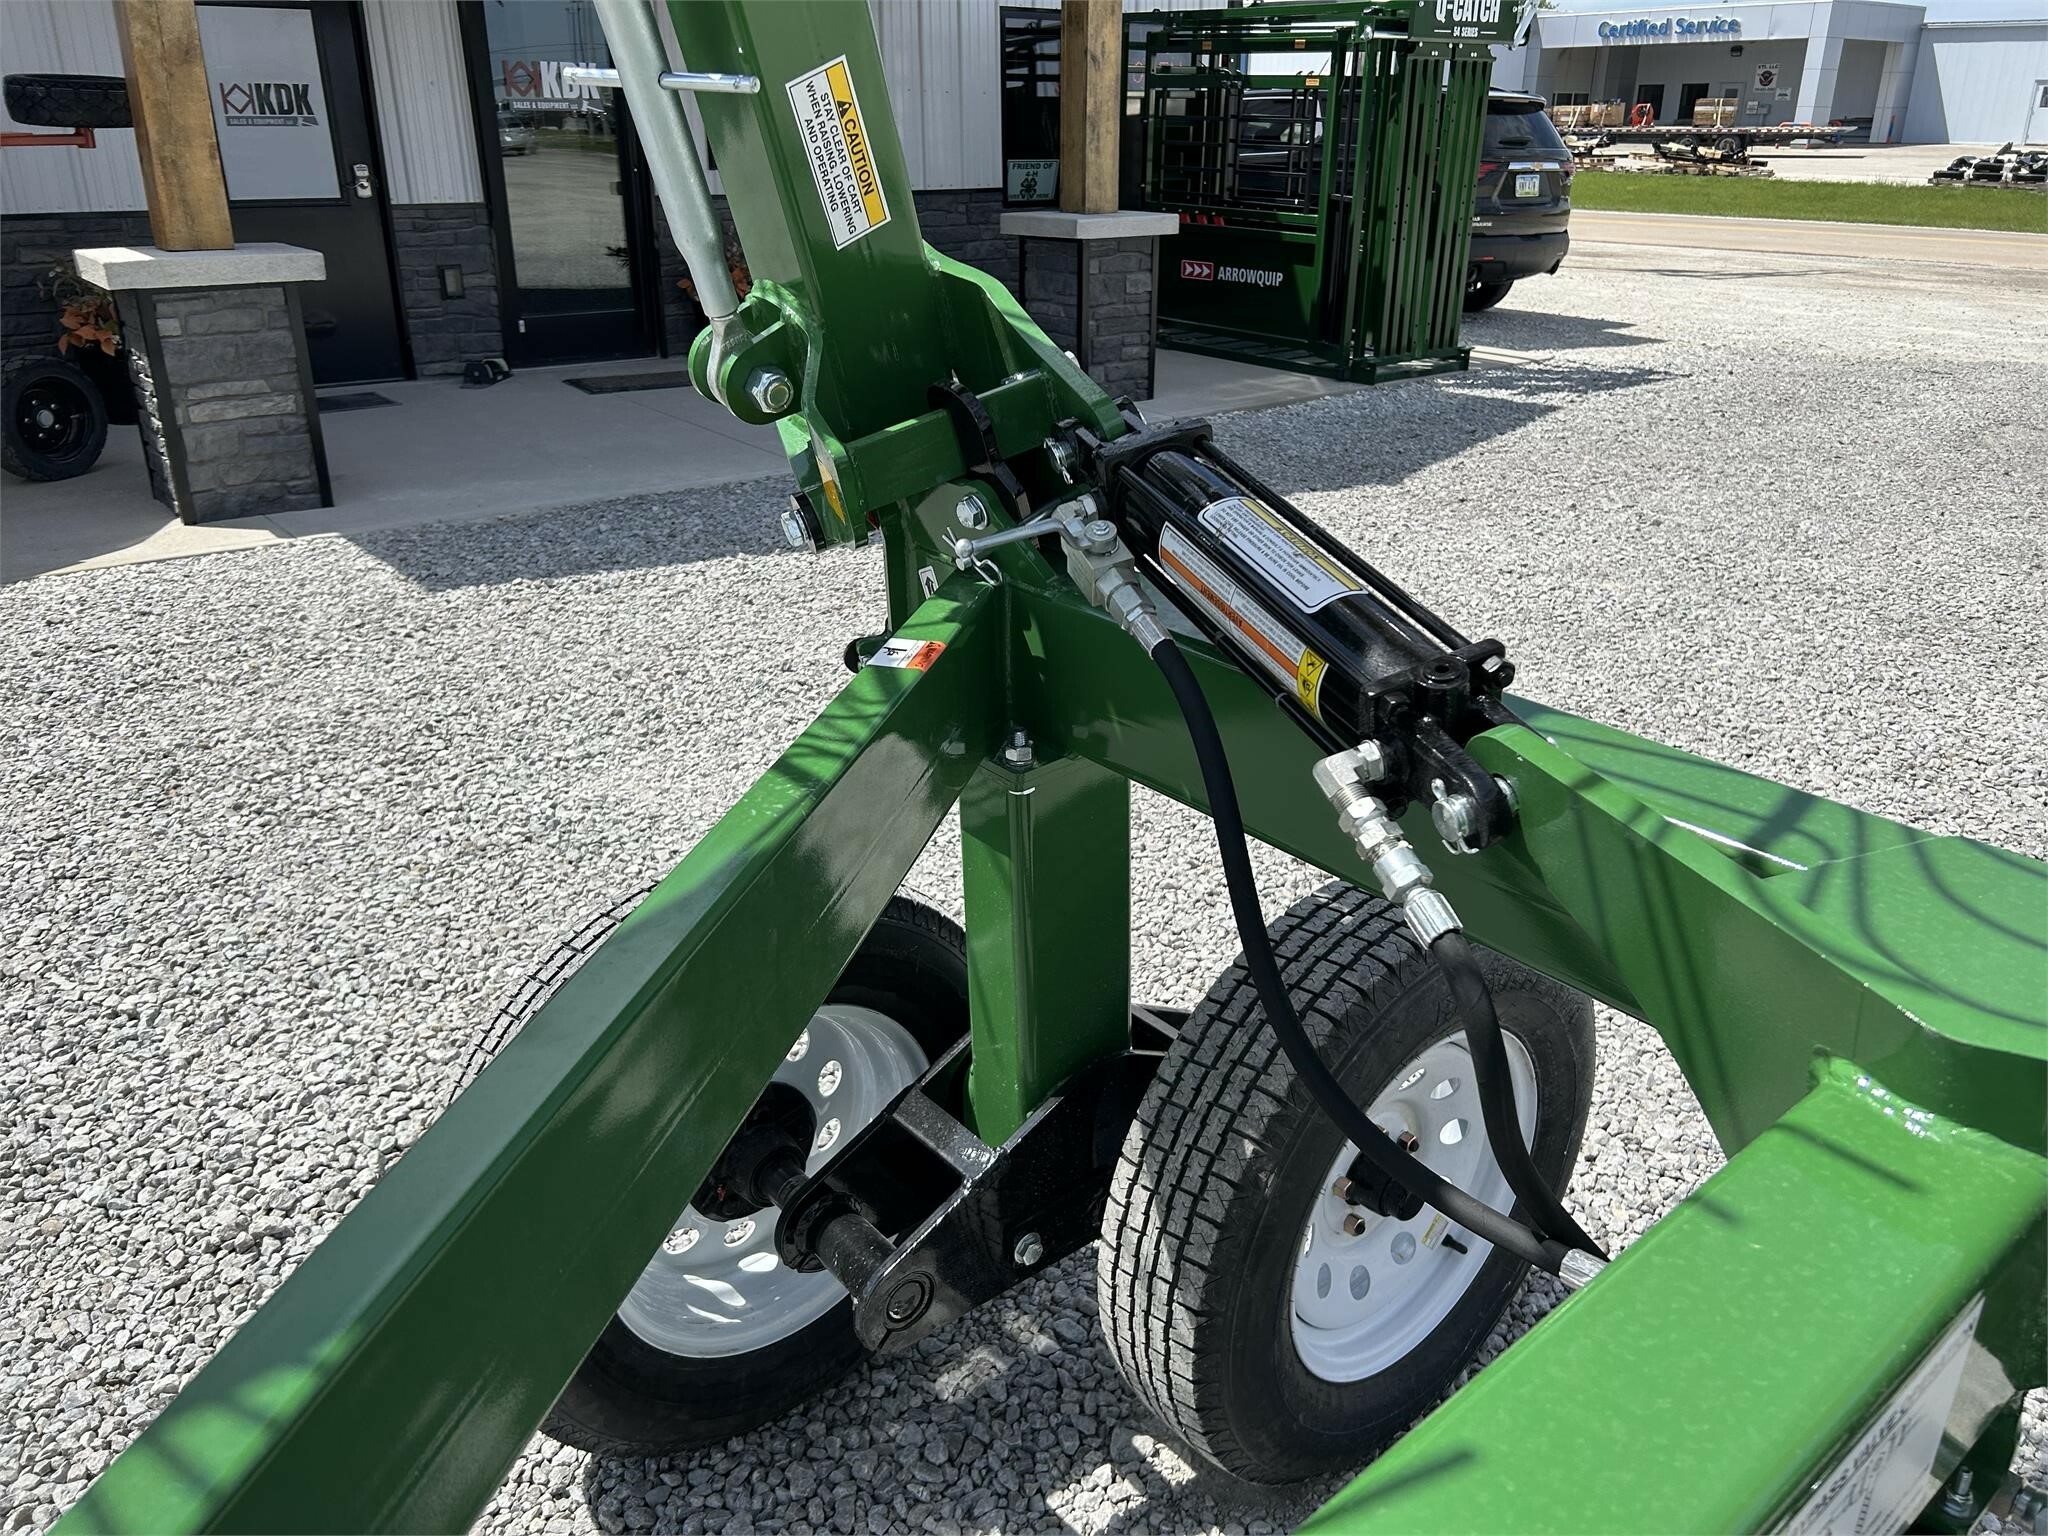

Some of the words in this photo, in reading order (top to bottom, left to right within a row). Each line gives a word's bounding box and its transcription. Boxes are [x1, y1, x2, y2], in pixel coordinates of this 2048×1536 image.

[1436, 0, 1500, 23] Q-CATCH
[1453, 26, 1460, 37] 54
[1461, 27, 1479, 37] SERIES
[1598, 18, 1672, 38] Certified
[1675, 16, 1741, 34] Service
[254, 83, 315, 115] KDK
[513, 101, 532, 109] SALES
[537, 102, 570, 110] EQUIPMENT
[820, 92, 836, 122] STAY
[805, 80, 820, 120] WHEN
[817, 121, 838, 173] RAISING,
[833, 175, 857, 235] LOWERING
[829, 124, 847, 166] CLEAR
[844, 118, 875, 197] CAUTION
[804, 118, 818, 144] AND
[813, 145, 839, 213] OPERATING
[842, 166, 853, 182] OF
[1043, 162, 1053, 170] OF
[847, 183, 862, 214] CART
[1217, 265, 1284, 287] ARROWQUIP
